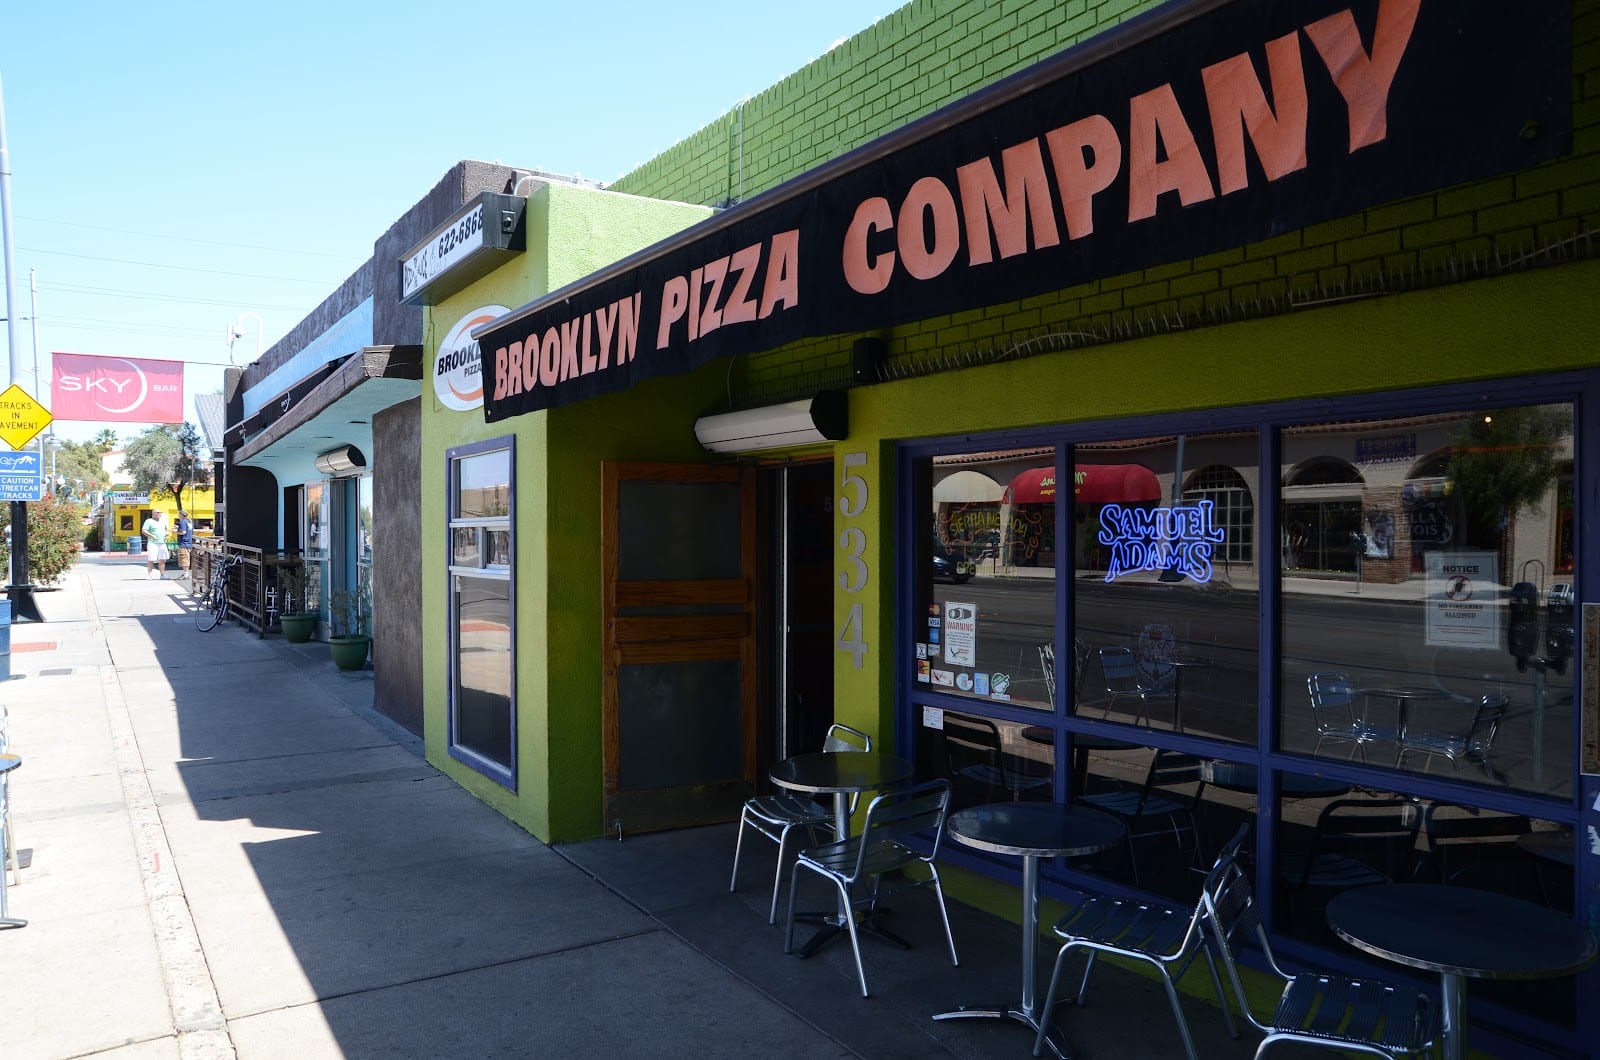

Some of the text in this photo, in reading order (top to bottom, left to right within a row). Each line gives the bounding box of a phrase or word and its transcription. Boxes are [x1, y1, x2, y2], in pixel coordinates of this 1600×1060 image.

[494, 0, 1421, 401] BROOKLYN PIZZA COMPANY
[438, 208, 483, 259] 622-6868
[59, 376, 177, 393] SKY BAR
[0, 402, 32, 410] TRACKS
[950, 511, 985, 537] SIERRA
[1099, 500, 1224, 545] SAMUEL
[838, 452, 869, 669] 534
[1104, 541, 1213, 583] ADAMS
[1443, 565, 1480, 573] NOTICE
[947, 621, 974, 631] WARNING
